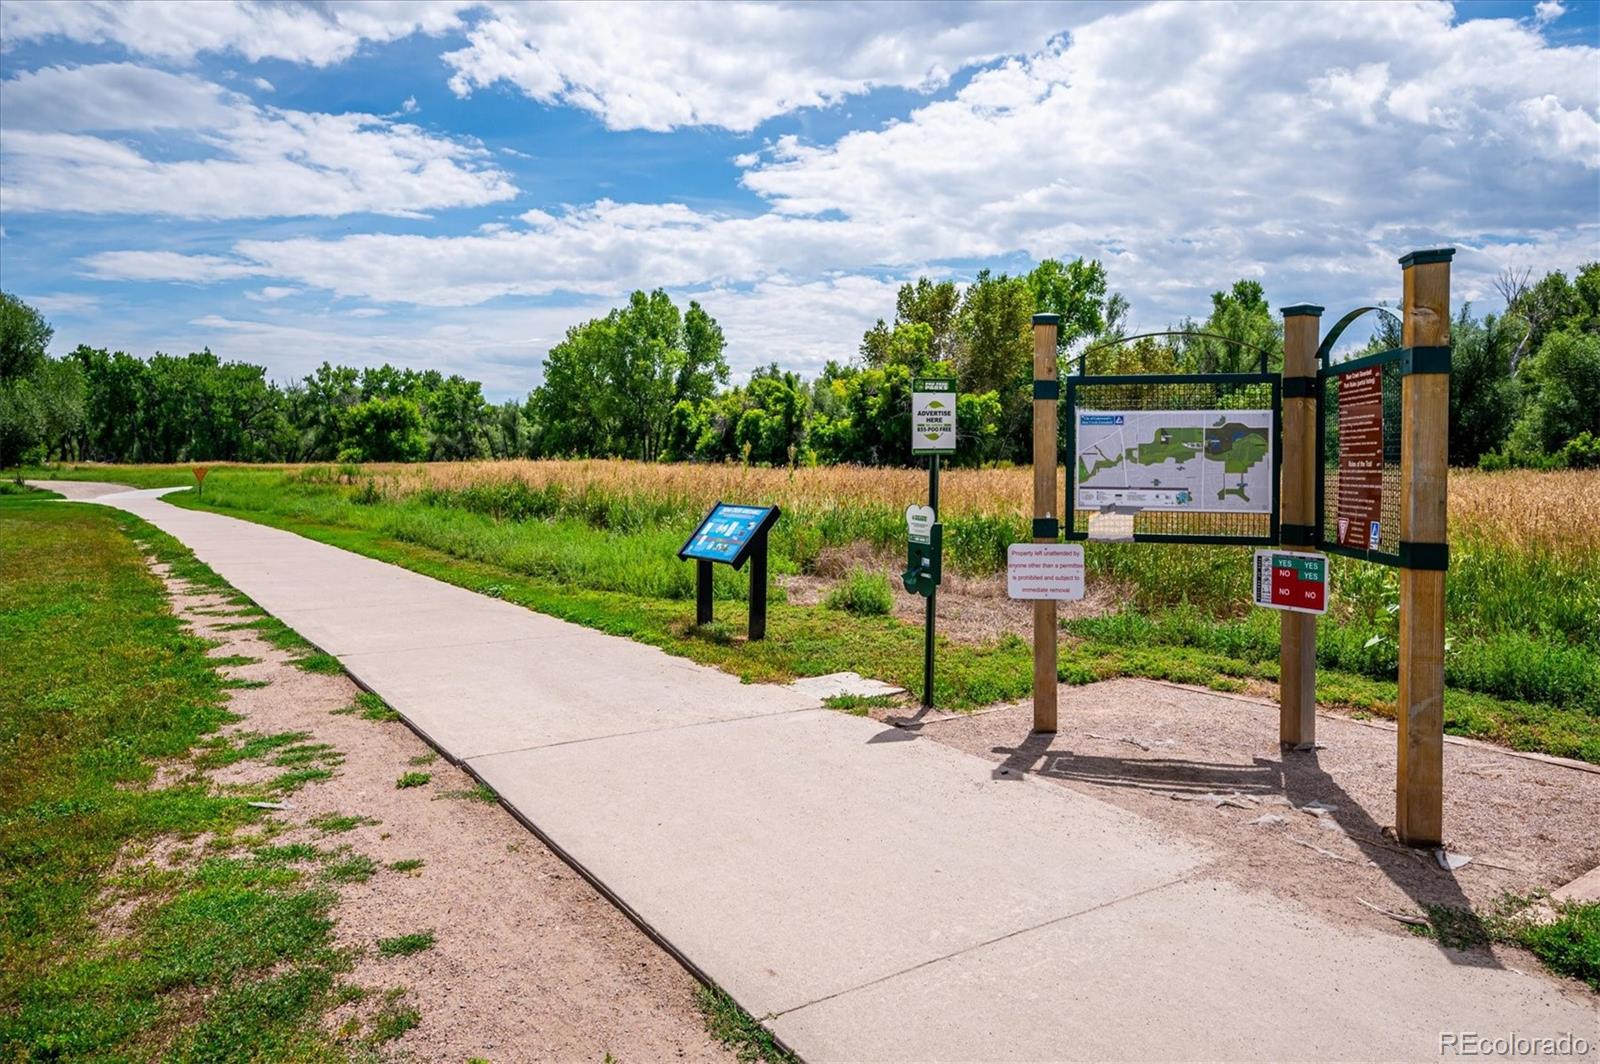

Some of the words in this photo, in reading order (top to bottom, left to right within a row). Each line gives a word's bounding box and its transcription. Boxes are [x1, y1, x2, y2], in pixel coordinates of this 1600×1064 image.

[1305, 562, 1318, 570] YES
[1279, 569, 1291, 577] NO
[1304, 572, 1318, 580] YES
[1278, 588, 1290, 596] NO
[1304, 591, 1317, 599] NO
